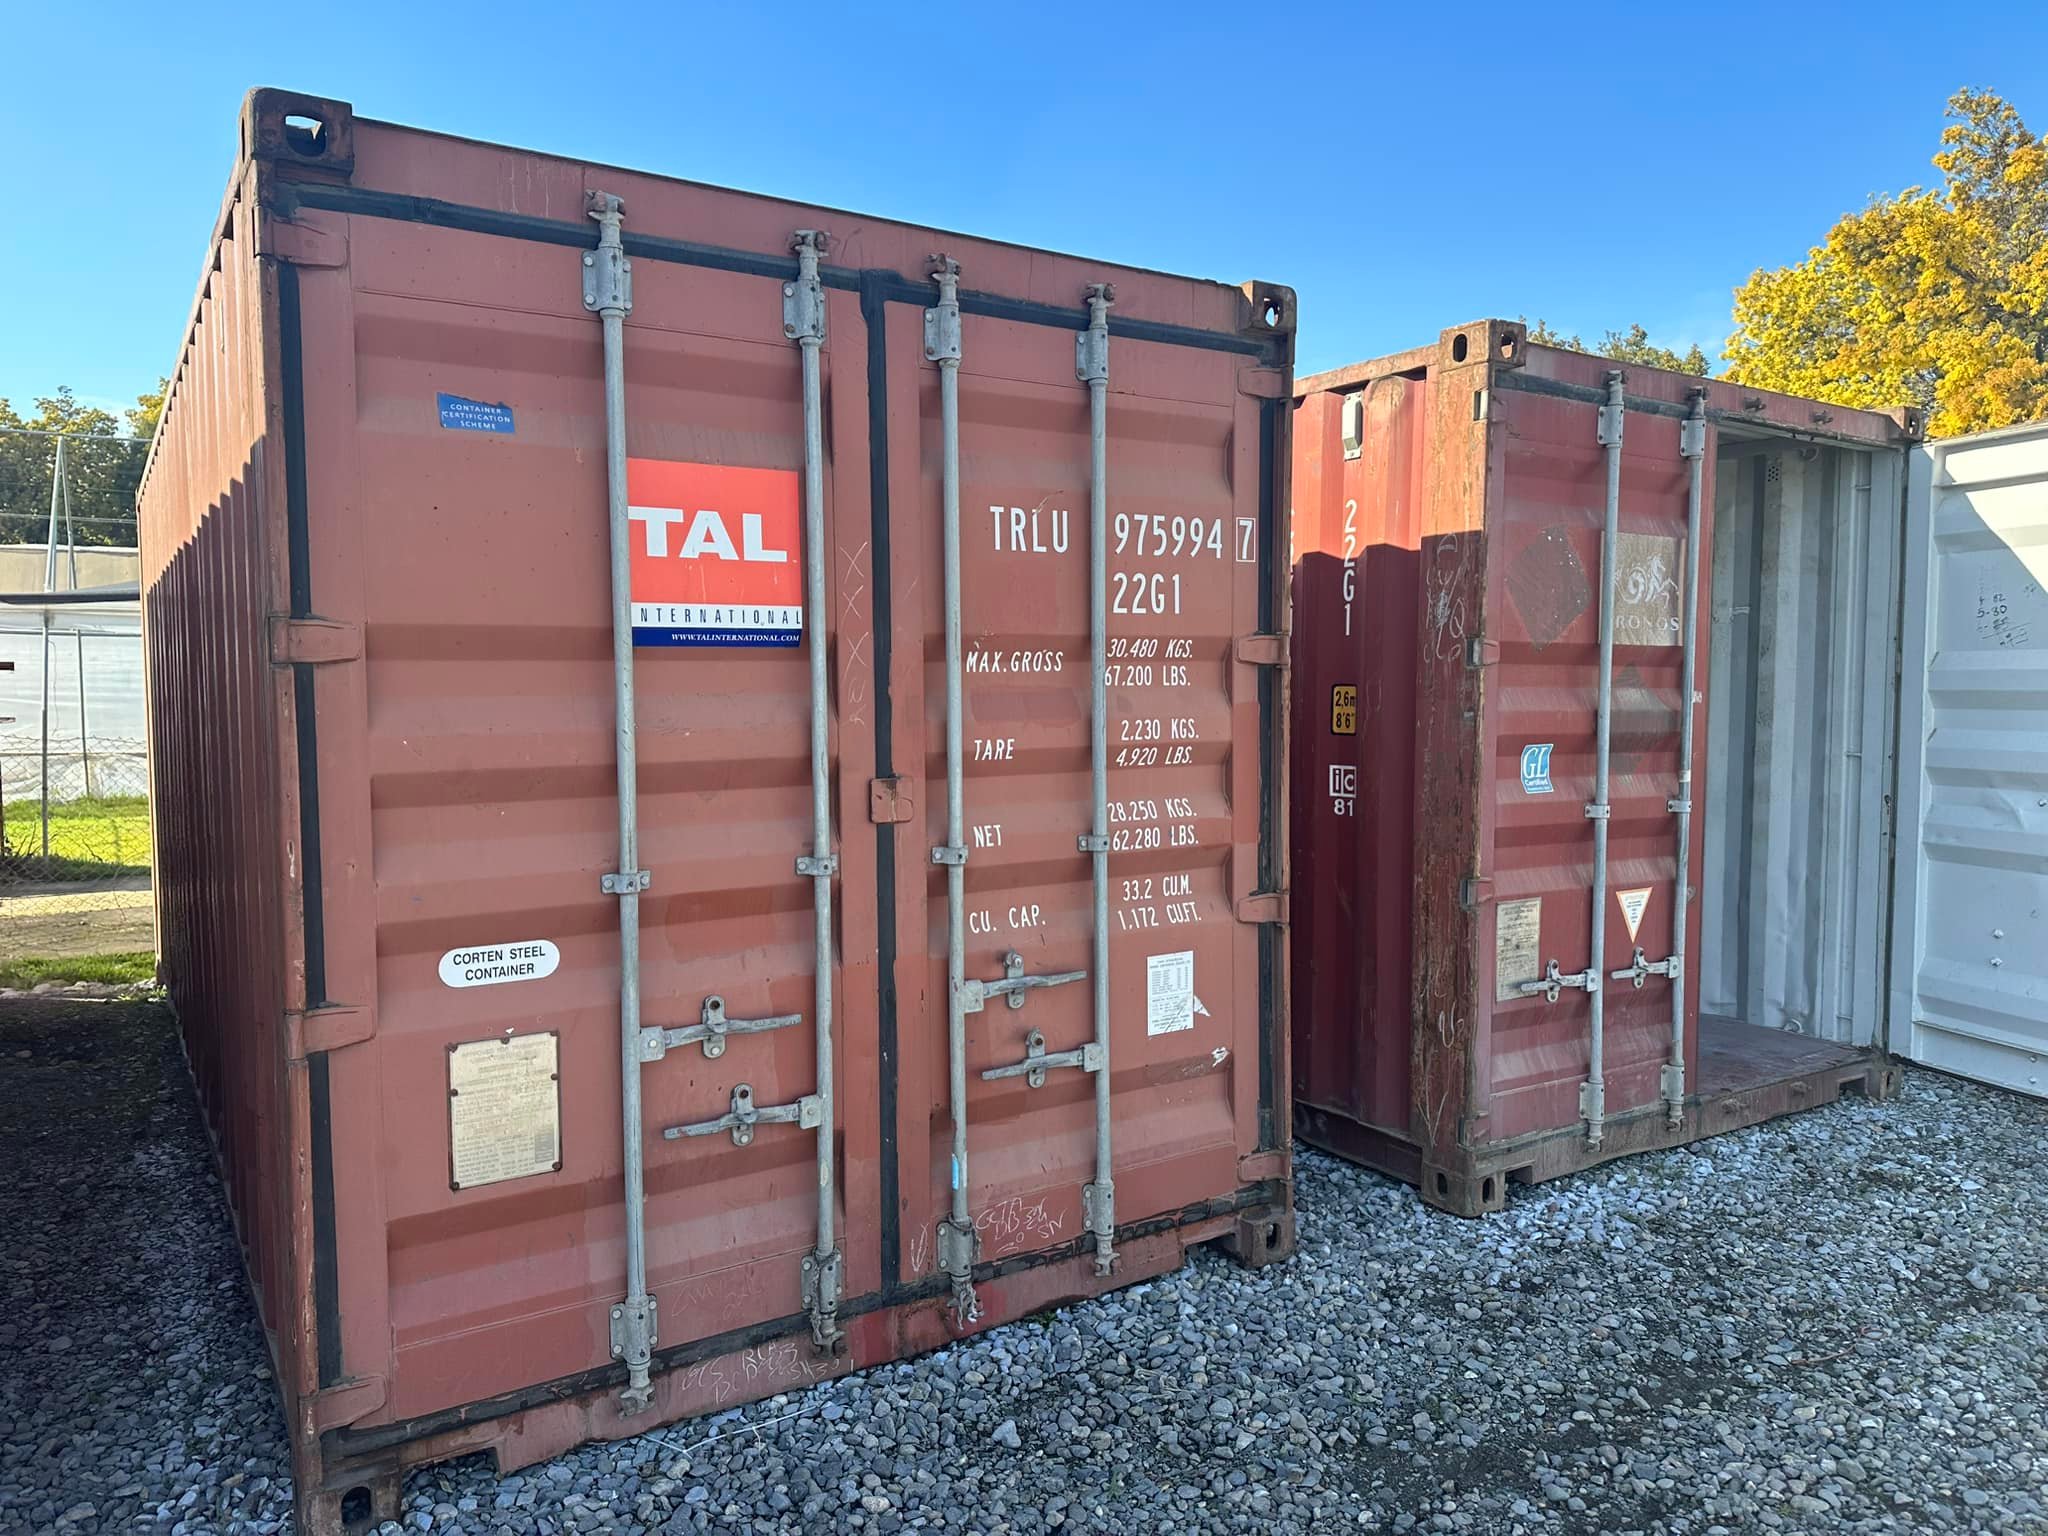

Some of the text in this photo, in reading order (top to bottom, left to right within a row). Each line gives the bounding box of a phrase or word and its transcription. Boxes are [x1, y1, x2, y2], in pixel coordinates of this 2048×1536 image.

[443, 410, 511, 423] CERTIFICATION
[449, 403, 501, 414] CONTAINER
[460, 420, 496, 430] SCHEME
[627, 505, 788, 563] TAL
[989, 505, 1253, 560] TRLU 975994 7
[1342, 499, 1357, 636] 22G1
[1112, 572, 1181, 615] 22G1
[640, 607, 801, 625] NTERNATIONAL
[1615, 614, 1680, 631] RONOS
[1165, 639, 1193, 658] KGS.
[1163, 665, 1191, 686] LBS.
[974, 738, 1015, 760] TARE
[1171, 718, 1200, 740] KGS.
[1165, 746, 1193, 765] LBS.
[1333, 798, 1354, 817] 81
[973, 824, 1001, 848] NET
[1165, 798, 1198, 819] KGS.
[1170, 825, 1199, 846] LBS.
[969, 911, 997, 933] CU.
[1008, 904, 1046, 928] CAP.
[1122, 878, 1152, 901] 33.2
[452, 945, 546, 966] CORTEN STEEL
[465, 962, 535, 981] CONTAINER
